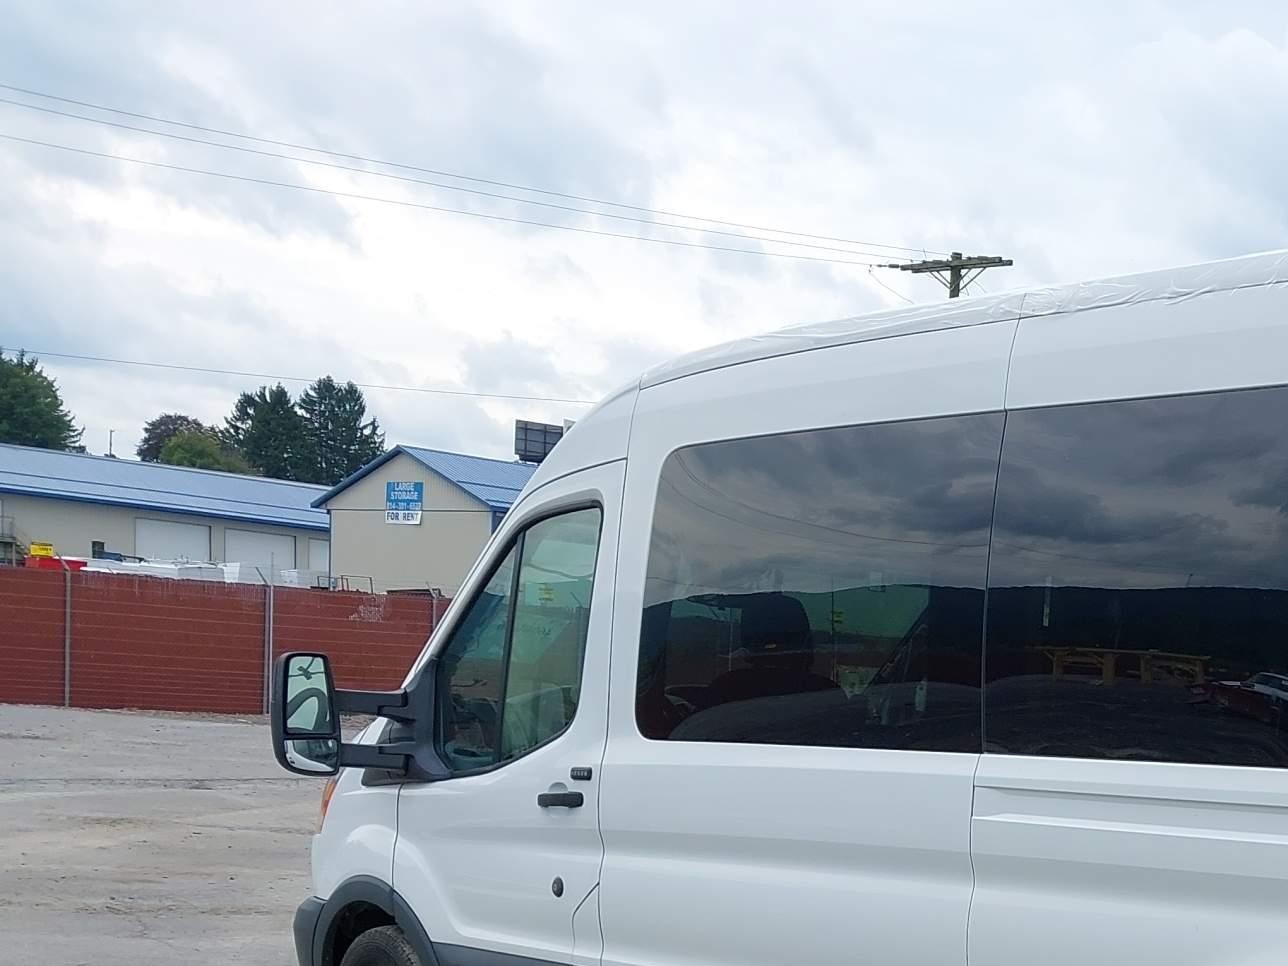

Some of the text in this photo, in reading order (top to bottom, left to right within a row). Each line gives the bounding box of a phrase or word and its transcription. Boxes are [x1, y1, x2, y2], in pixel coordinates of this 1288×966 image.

[394, 482, 415, 491] LARGE
[390, 491, 418, 500] STORAGE
[386, 512, 419, 521] FOR RENT
